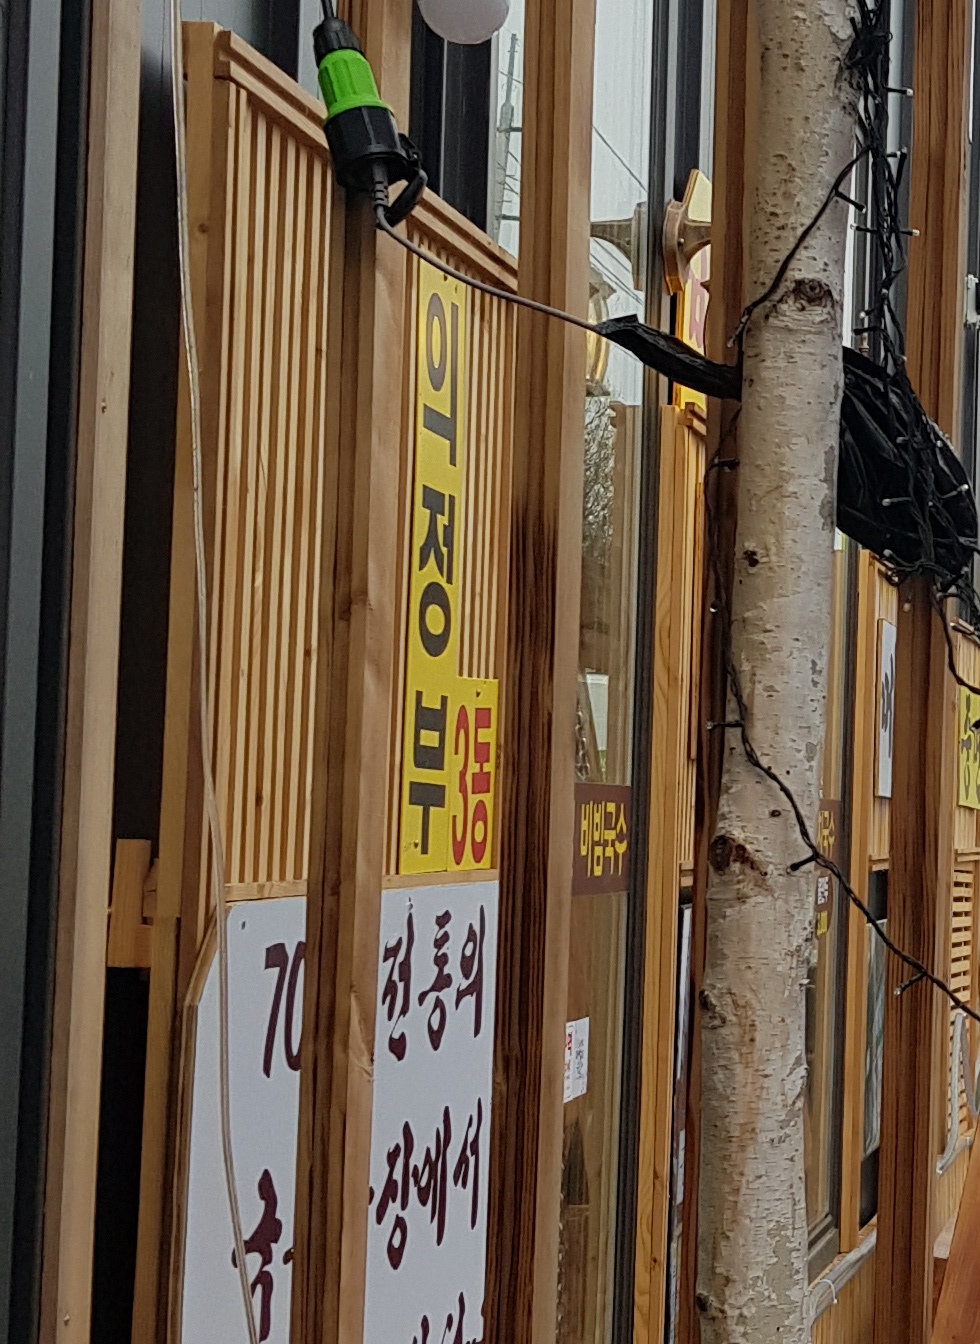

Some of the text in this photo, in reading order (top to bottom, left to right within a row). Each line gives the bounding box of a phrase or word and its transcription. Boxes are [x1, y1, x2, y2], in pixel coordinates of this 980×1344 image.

[408, 292, 460, 856] 의정부
[451, 704, 492, 865] 3동
[580, 800, 628, 877] 비빔국수
[382, 904, 486, 1062] 전통의
